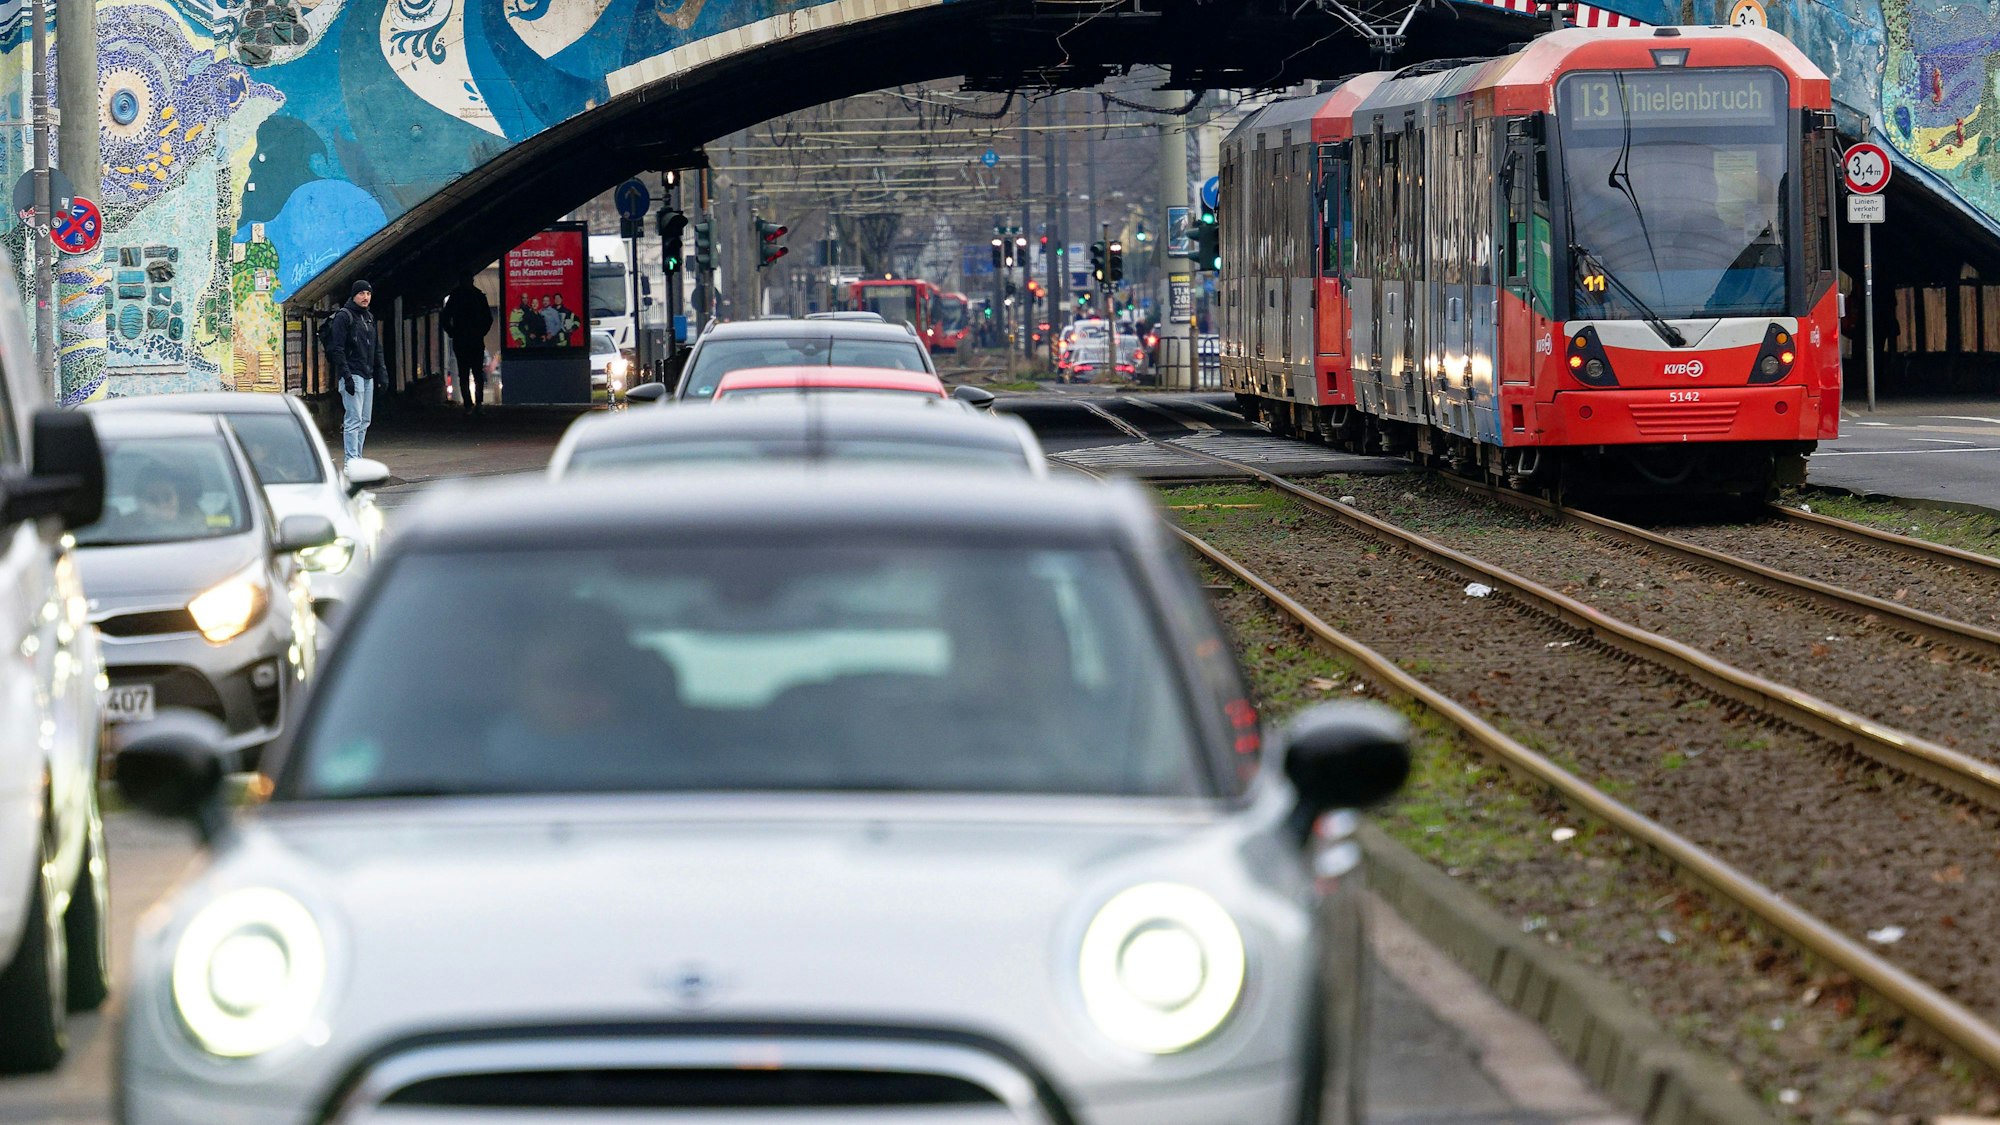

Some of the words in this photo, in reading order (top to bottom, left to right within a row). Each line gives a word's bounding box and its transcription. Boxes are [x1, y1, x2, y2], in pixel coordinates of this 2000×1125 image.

[1580, 83, 1609, 117] 13
[1621, 82, 1762, 112] Thielenbruch
[522, 249, 554, 257] Einsatz
[509, 259, 522, 267] für
[524, 258, 543, 266] Köln
[552, 258, 573, 266] auch
[509, 269, 521, 277] an
[522, 268, 563, 276] Karneval!
[1583, 275, 1605, 292] 11
[1663, 364, 1687, 375] KVB
[1669, 391, 1700, 402] 5142
[1682, 433, 1688, 441] 1
